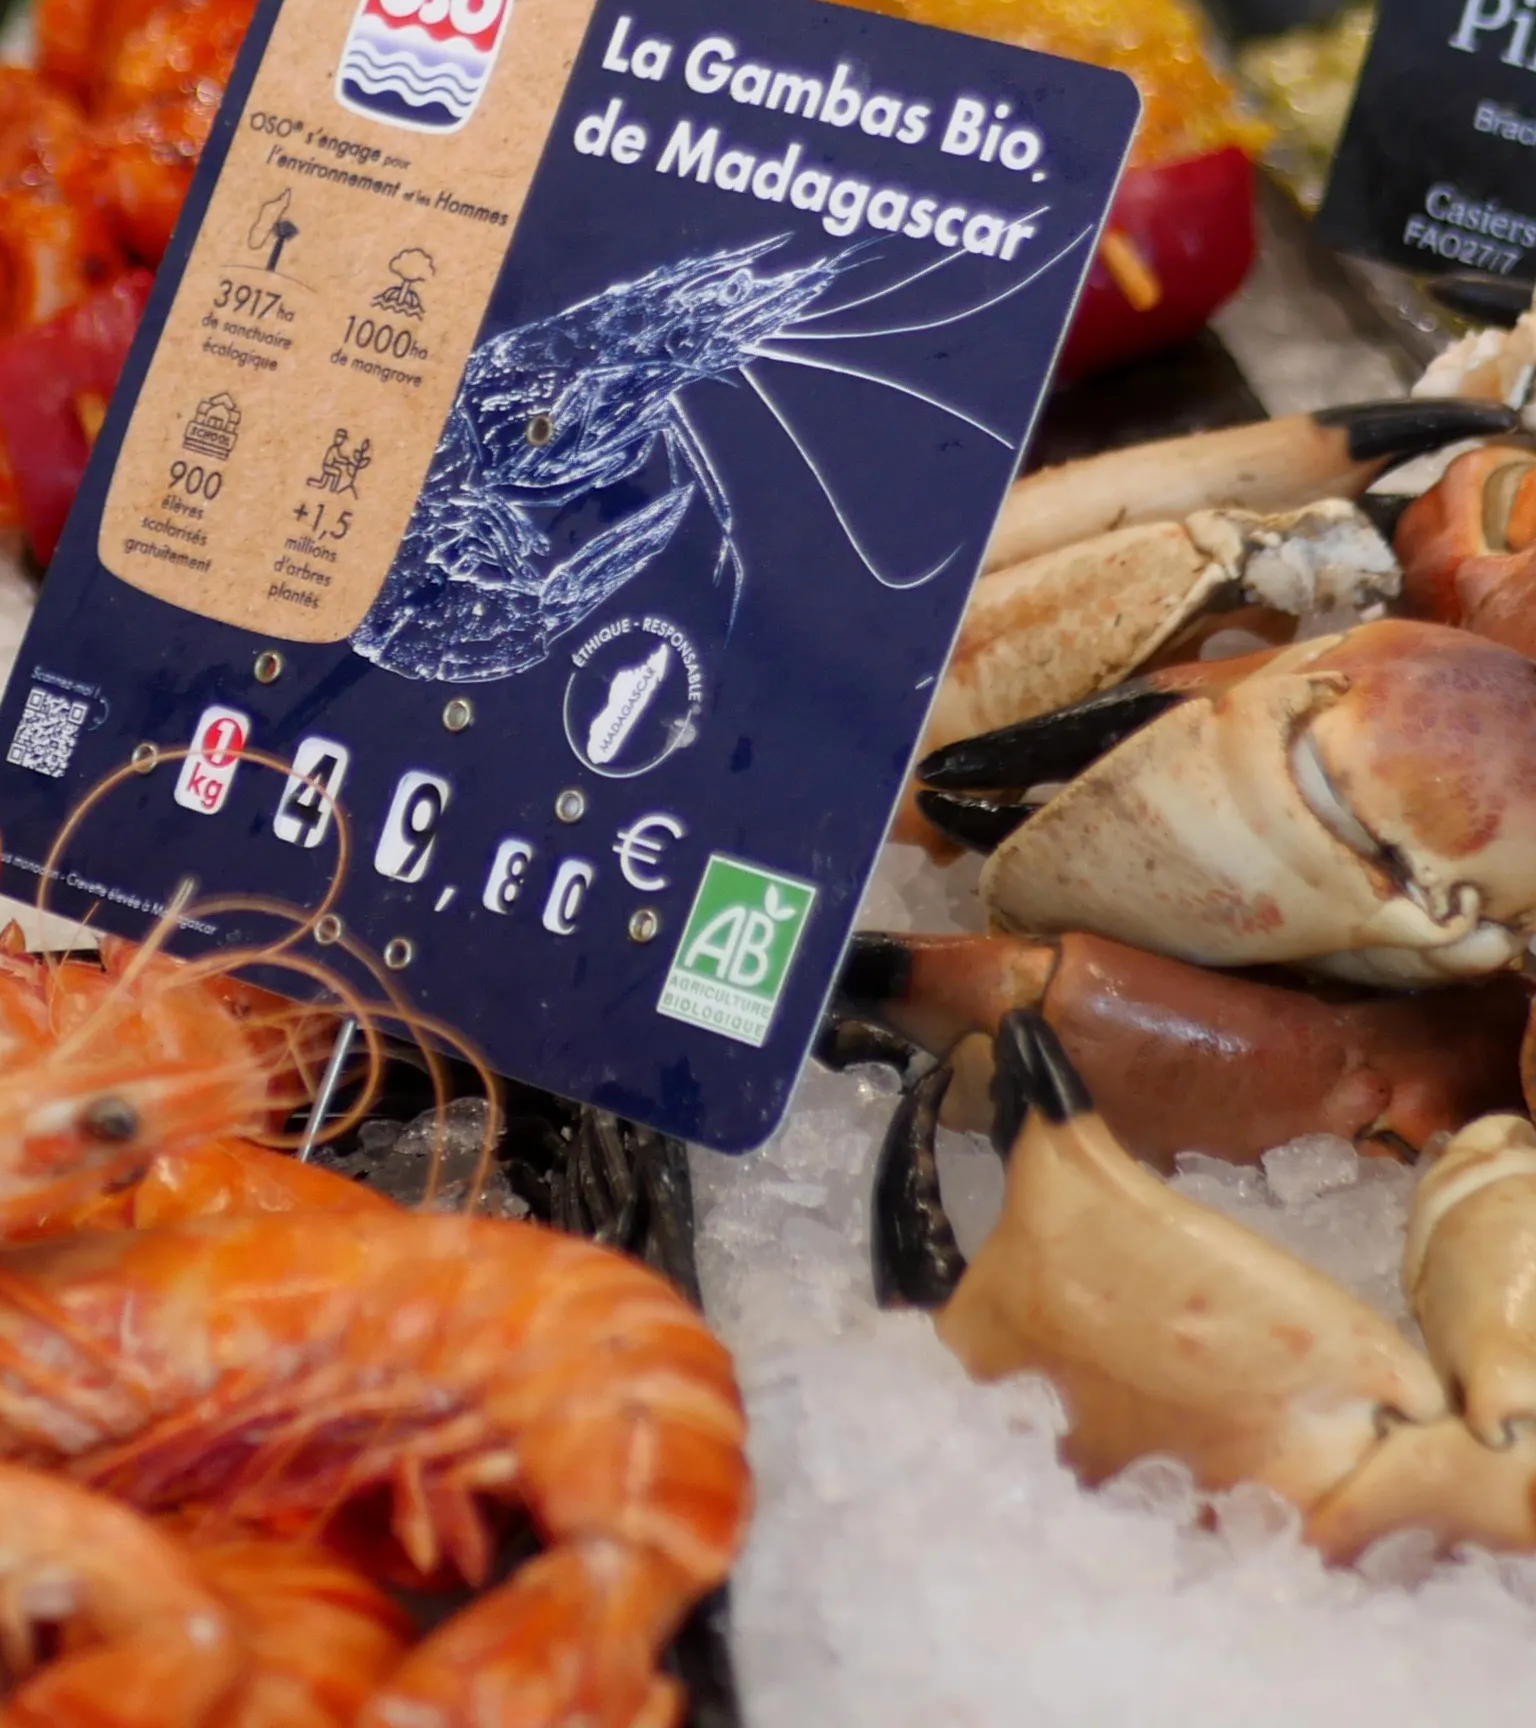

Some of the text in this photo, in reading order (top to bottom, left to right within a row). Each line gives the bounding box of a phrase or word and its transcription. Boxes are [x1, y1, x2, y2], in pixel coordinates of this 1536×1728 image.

[602, 16, 672, 82] La
[685, 36, 931, 145] Gambas
[304, 128, 381, 163] s'engage
[383, 154, 411, 170] pour
[266, 145, 400, 198] l'environnement
[434, 191, 509, 228] Hommes
[574, 98, 1037, 261] de Madagascar
[202, 313, 293, 351] de sanctuaire
[202, 336, 278, 372] écologique
[330, 348, 423, 388] de mangrove
[168, 460, 223, 501] 900
[161, 493, 204, 520] élèves
[293, 503, 354, 541] +1,5
[141, 517, 208, 547] scolarisés
[284, 537, 337, 563] millions
[123, 537, 212, 572] gratuitement
[273, 557, 332, 587] d'arbres
[267, 582, 320, 609] plantés
[642, 616, 703, 702] RESPONSABLE
[599, 666, 657, 754] MADAGASCAR
[187, 762, 223, 810] kg
[684, 905, 775, 987] AB
[663, 992, 763, 1038] BIOLOGIQUE
[669, 974, 772, 1020] AGRICULTURE
